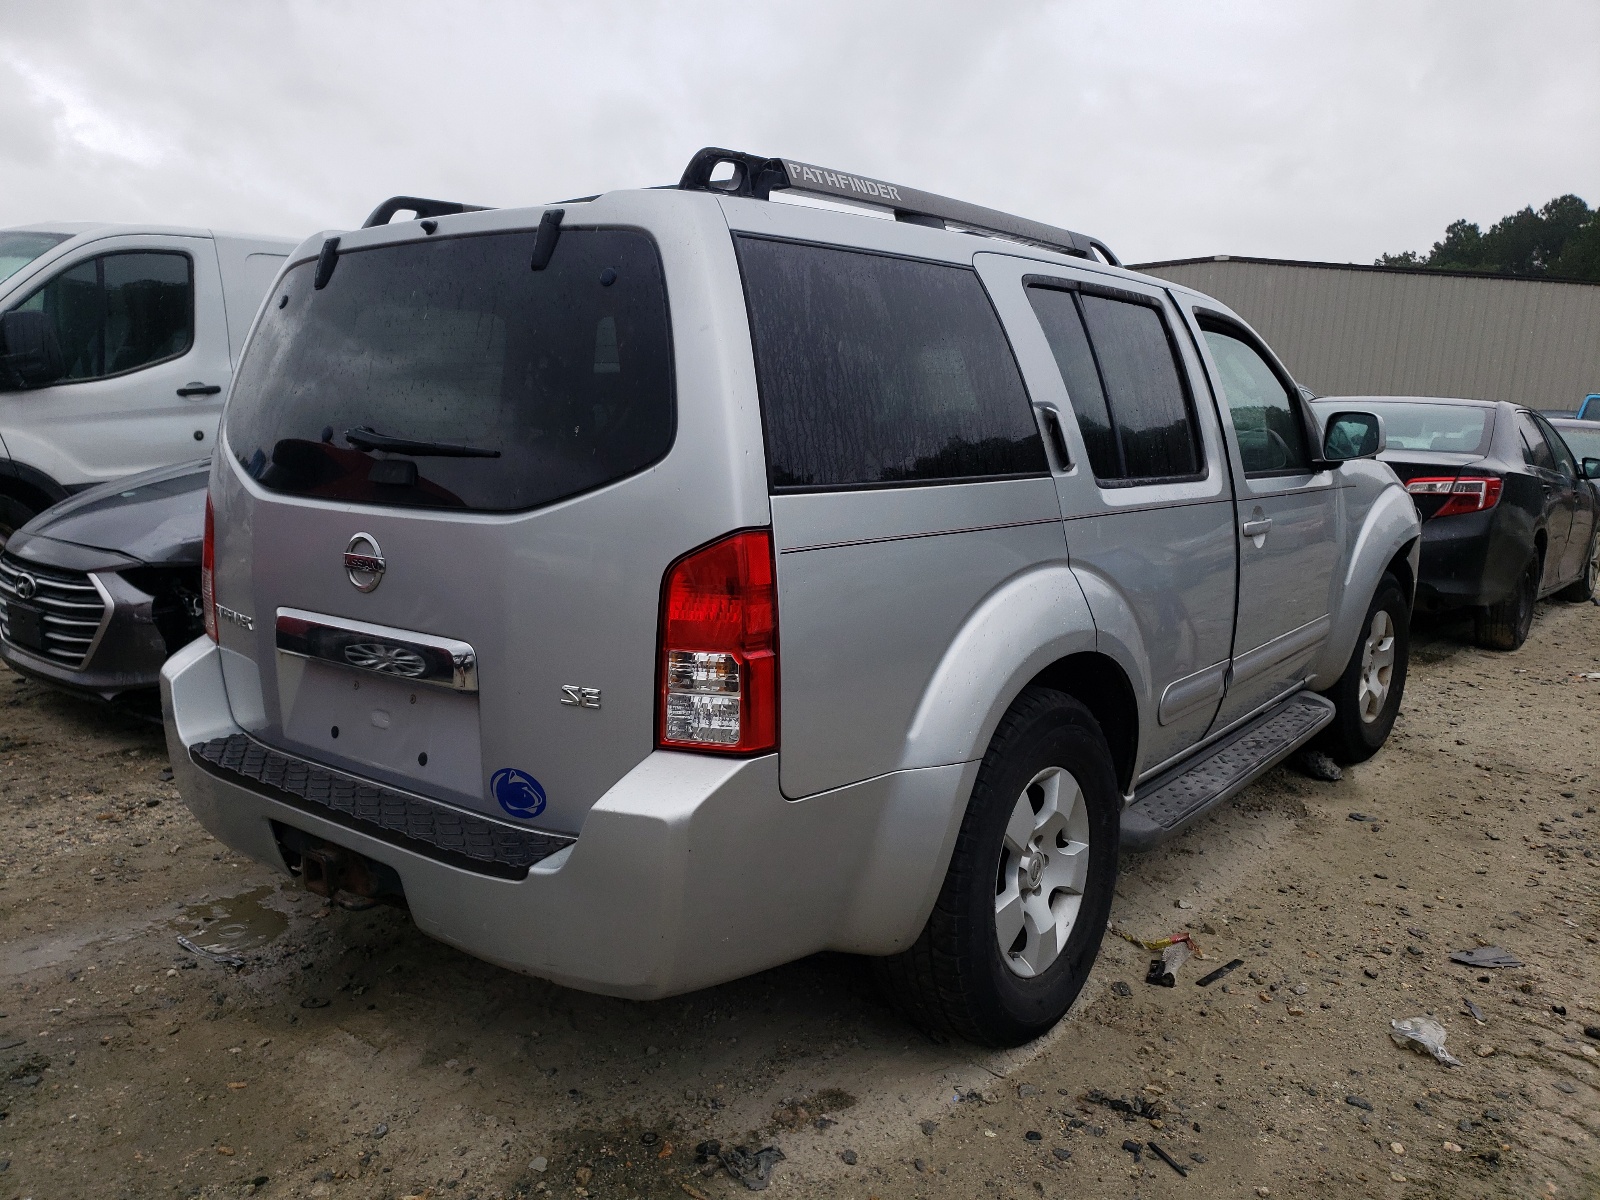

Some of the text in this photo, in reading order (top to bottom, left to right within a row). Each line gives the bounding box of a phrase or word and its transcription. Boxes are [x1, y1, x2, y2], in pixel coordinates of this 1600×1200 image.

[788, 163, 902, 201] PATHFINDER
[345, 556, 380, 571] NISSAN
[560, 684, 601, 709] SE
